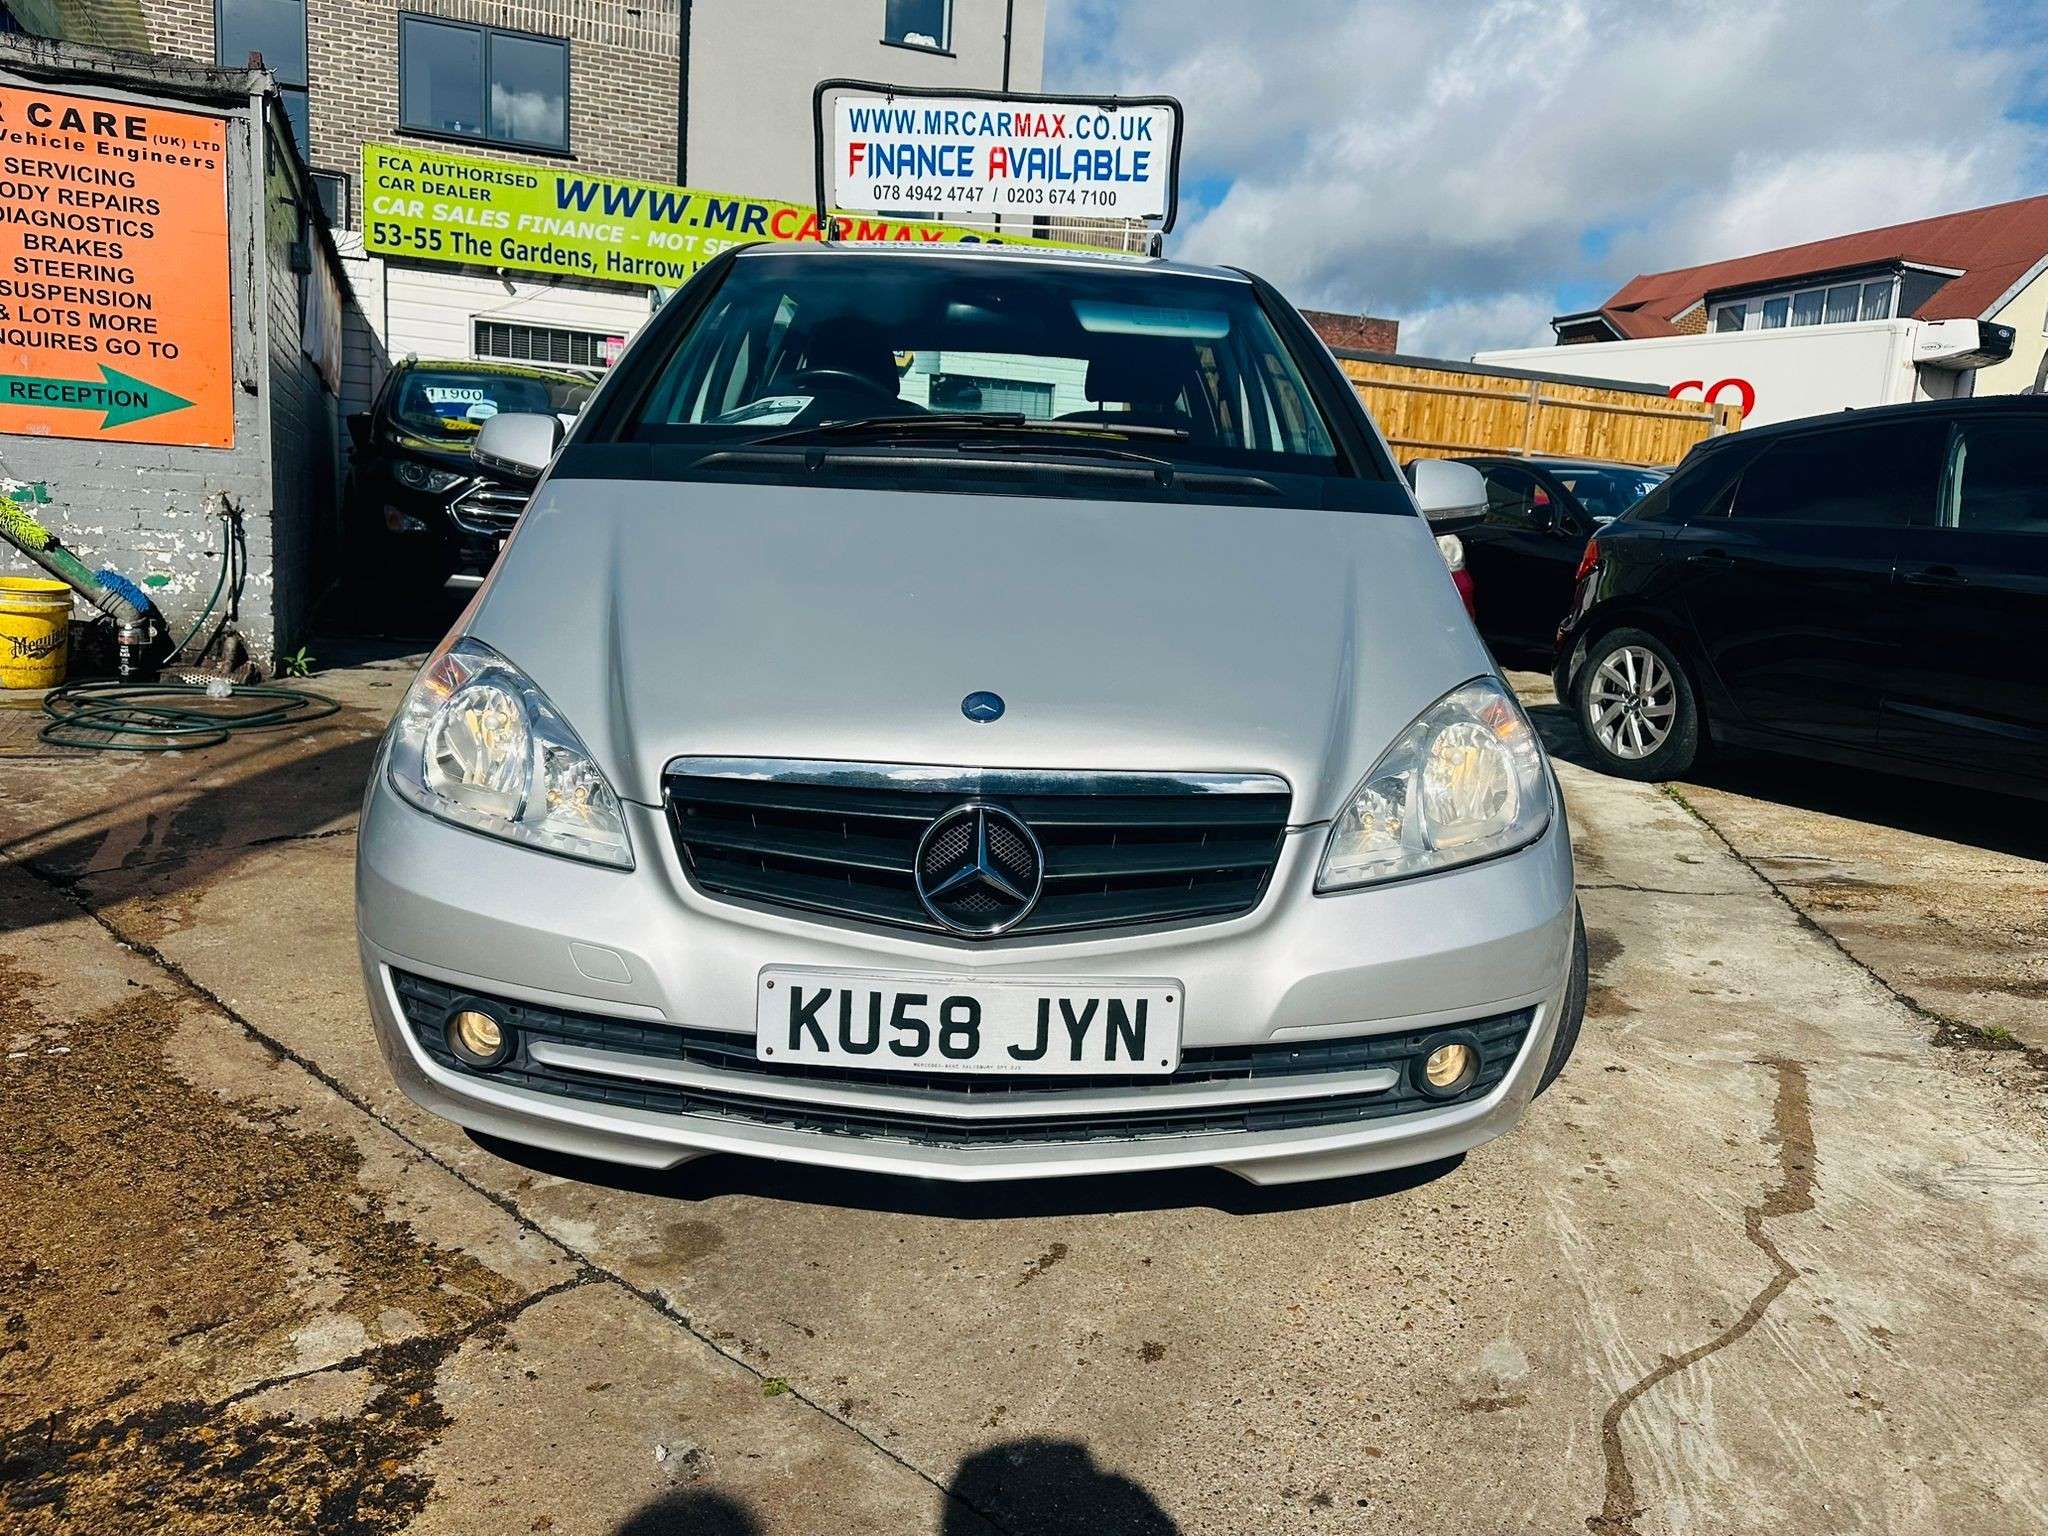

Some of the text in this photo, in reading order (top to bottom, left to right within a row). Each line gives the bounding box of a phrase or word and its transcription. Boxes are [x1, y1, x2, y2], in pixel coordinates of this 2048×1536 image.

[27, 102, 148, 142] CARE
[848, 107, 1154, 142] WWW.MRCARMAX.CO.UK
[97, 141, 216, 170] Engineers
[153, 134, 221, 152] (UK) LTD
[4, 157, 136, 189] SERVICING
[378, 156, 538, 189] FCA AUTHORISED
[848, 141, 1151, 184] FINANCE AVAILABLE
[58, 188, 161, 216] REPAIRS
[378, 175, 492, 202] CAR DEALER
[872, 184, 901, 201] 078
[905, 184, 943, 202] 4942
[946, 186, 985, 203] 4747
[1006, 188, 1044, 205] 0203
[1048, 189, 1076, 206] 674
[1080, 190, 1117, 207] 7100
[0, 206, 155, 239] IAGNOSTICS
[372, 196, 424, 220] CAR
[431, 202, 512, 230] SALES
[517, 214, 625, 244] FINANCE
[647, 230, 699, 253] MOT
[703, 238, 738, 255] SE
[24, 233, 124, 260] BRAKES
[372, 221, 443, 251] 53-55
[450, 230, 493, 257] The
[500, 237, 599, 274] Gardens,
[607, 251, 684, 280] Harrow
[14, 256, 135, 285] STEERING
[0, 279, 152, 310] SUSPENSION
[18, 305, 82, 327] LOTS
[89, 312, 158, 334] MORE
[105, 338, 141, 356] GO
[148, 341, 179, 359] TO
[10, 381, 148, 409] RECEPTION
[788, 985, 1149, 1062] KU58 JYN
